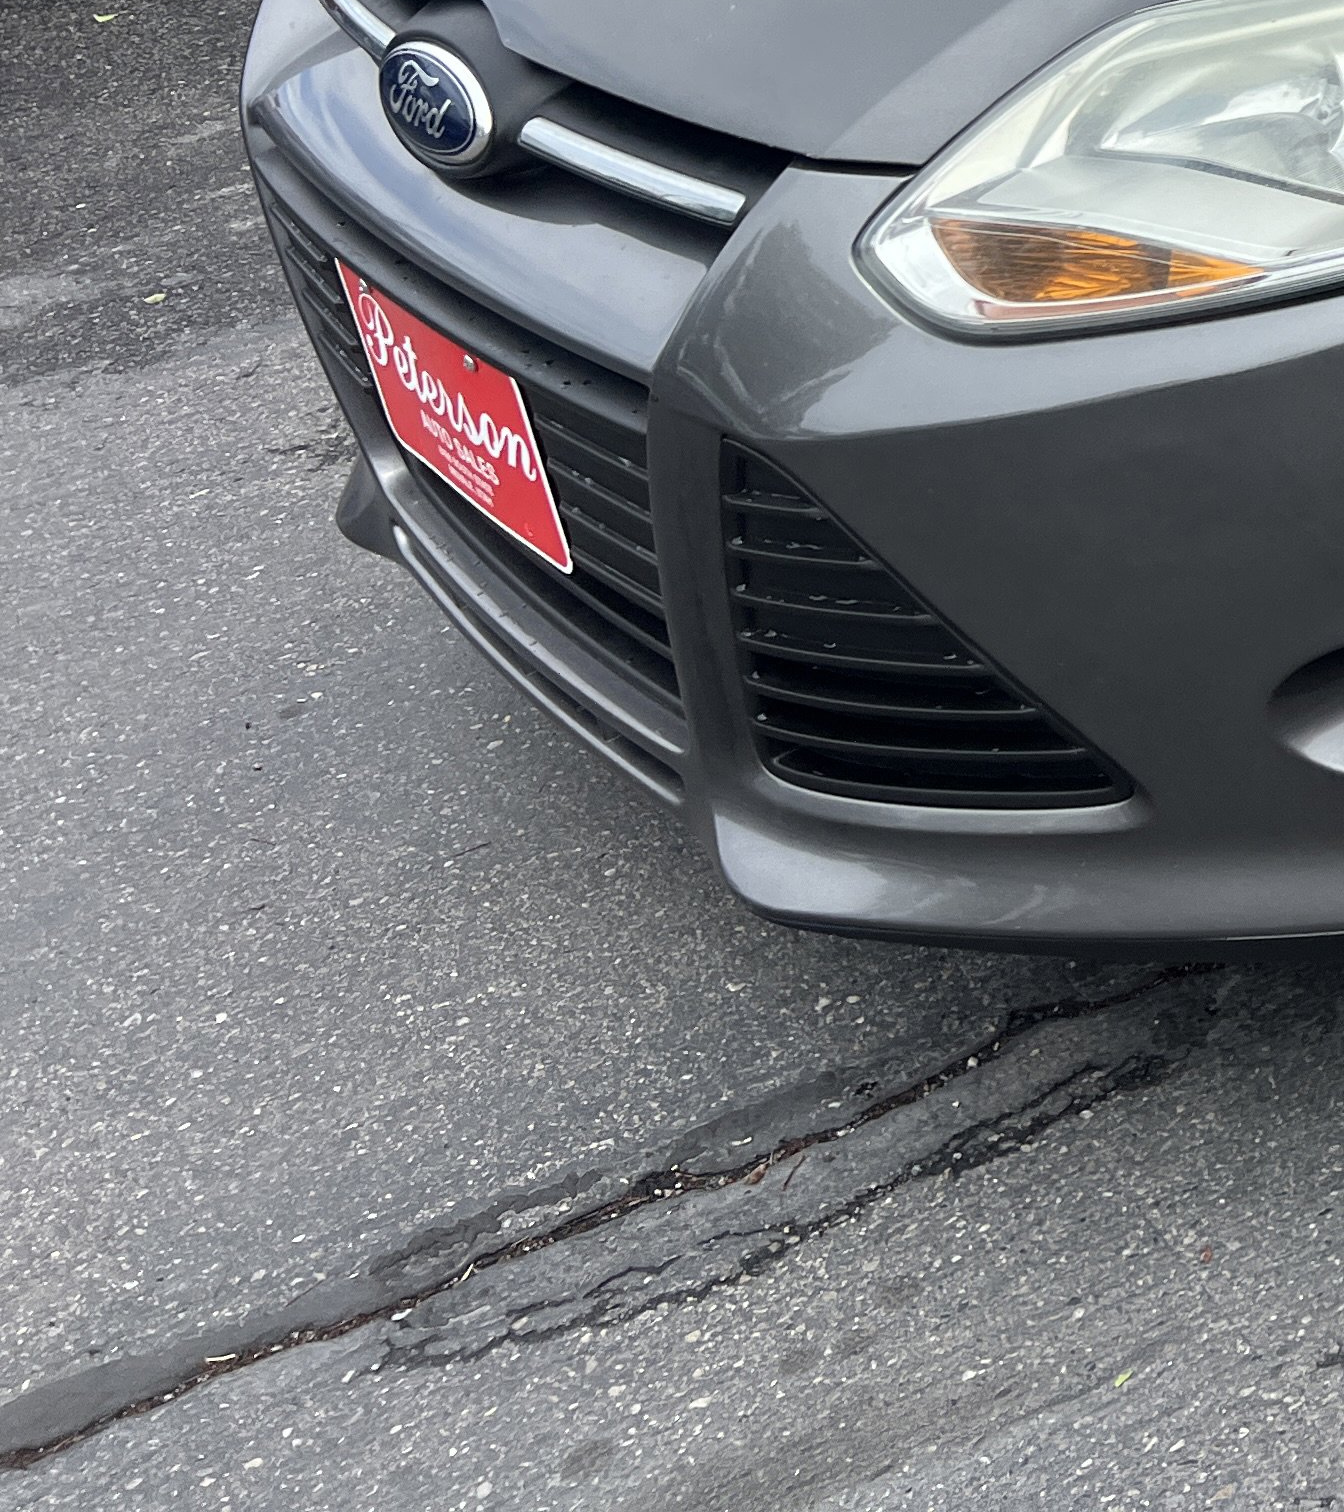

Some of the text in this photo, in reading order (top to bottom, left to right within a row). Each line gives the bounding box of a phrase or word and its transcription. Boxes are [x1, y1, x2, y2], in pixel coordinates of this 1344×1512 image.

[390, 59, 452, 139] Ford
[358, 292, 537, 482] Peterson
[420, 409, 454, 450] AUTO
[453, 437, 500, 486] SALES
